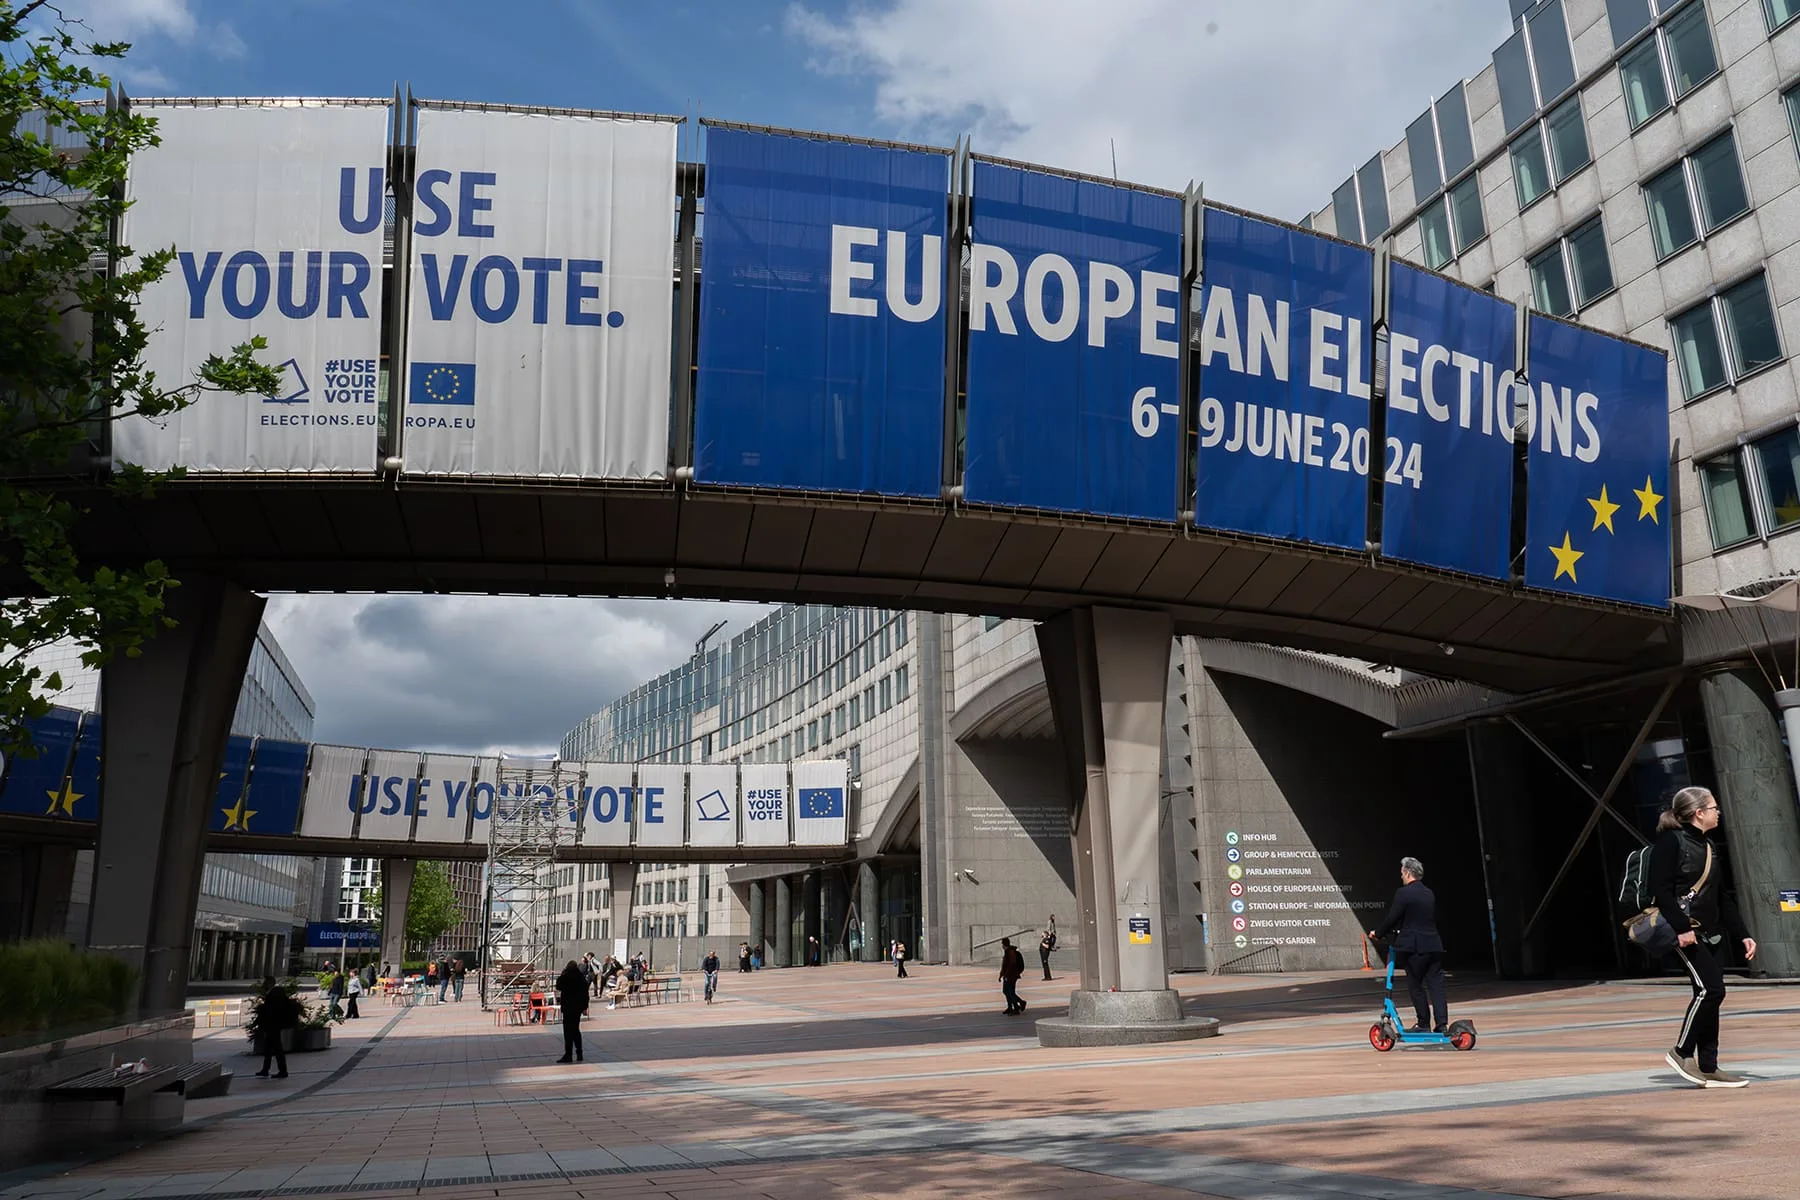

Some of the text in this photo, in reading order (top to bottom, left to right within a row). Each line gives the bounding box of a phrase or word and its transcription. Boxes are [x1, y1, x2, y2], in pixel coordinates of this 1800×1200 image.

[338, 167, 497, 238] USE
[178, 250, 625, 329] YOUR VOTE.
[829, 223, 1601, 464] EUROPEAN ELECTIONS
[324, 358, 376, 373] #USE
[324, 374, 376, 388] YOUR
[323, 389, 376, 403] VOTE
[260, 414, 477, 430] ELECTIONS.EUROPA.EU
[1330, 421, 1423, 490] 2024
[348, 774, 431, 818] USE
[565, 785, 665, 823] VOTE
[747, 789, 783, 800] #USE
[747, 800, 783, 810] YOUR
[748, 810, 783, 821] VOTE
[1244, 851, 1269, 859] GROUP
[1270, 851, 1276, 859] &
[1277, 851, 1316, 859] HEMICYCLE
[1245, 868, 1312, 876] PARLAMENTARIUM
[1284, 885, 1322, 893] EUROPEAN
[1323, 885, 1353, 893] HISTORY
[1314, 902, 1364, 910] INFORMATION
[1364, 901, 1386, 909] POINT
[1250, 920, 1274, 928] ZWEIG
[1303, 919, 1331, 927] CENTRE
[1285, 936, 1316, 945] GARDEN
